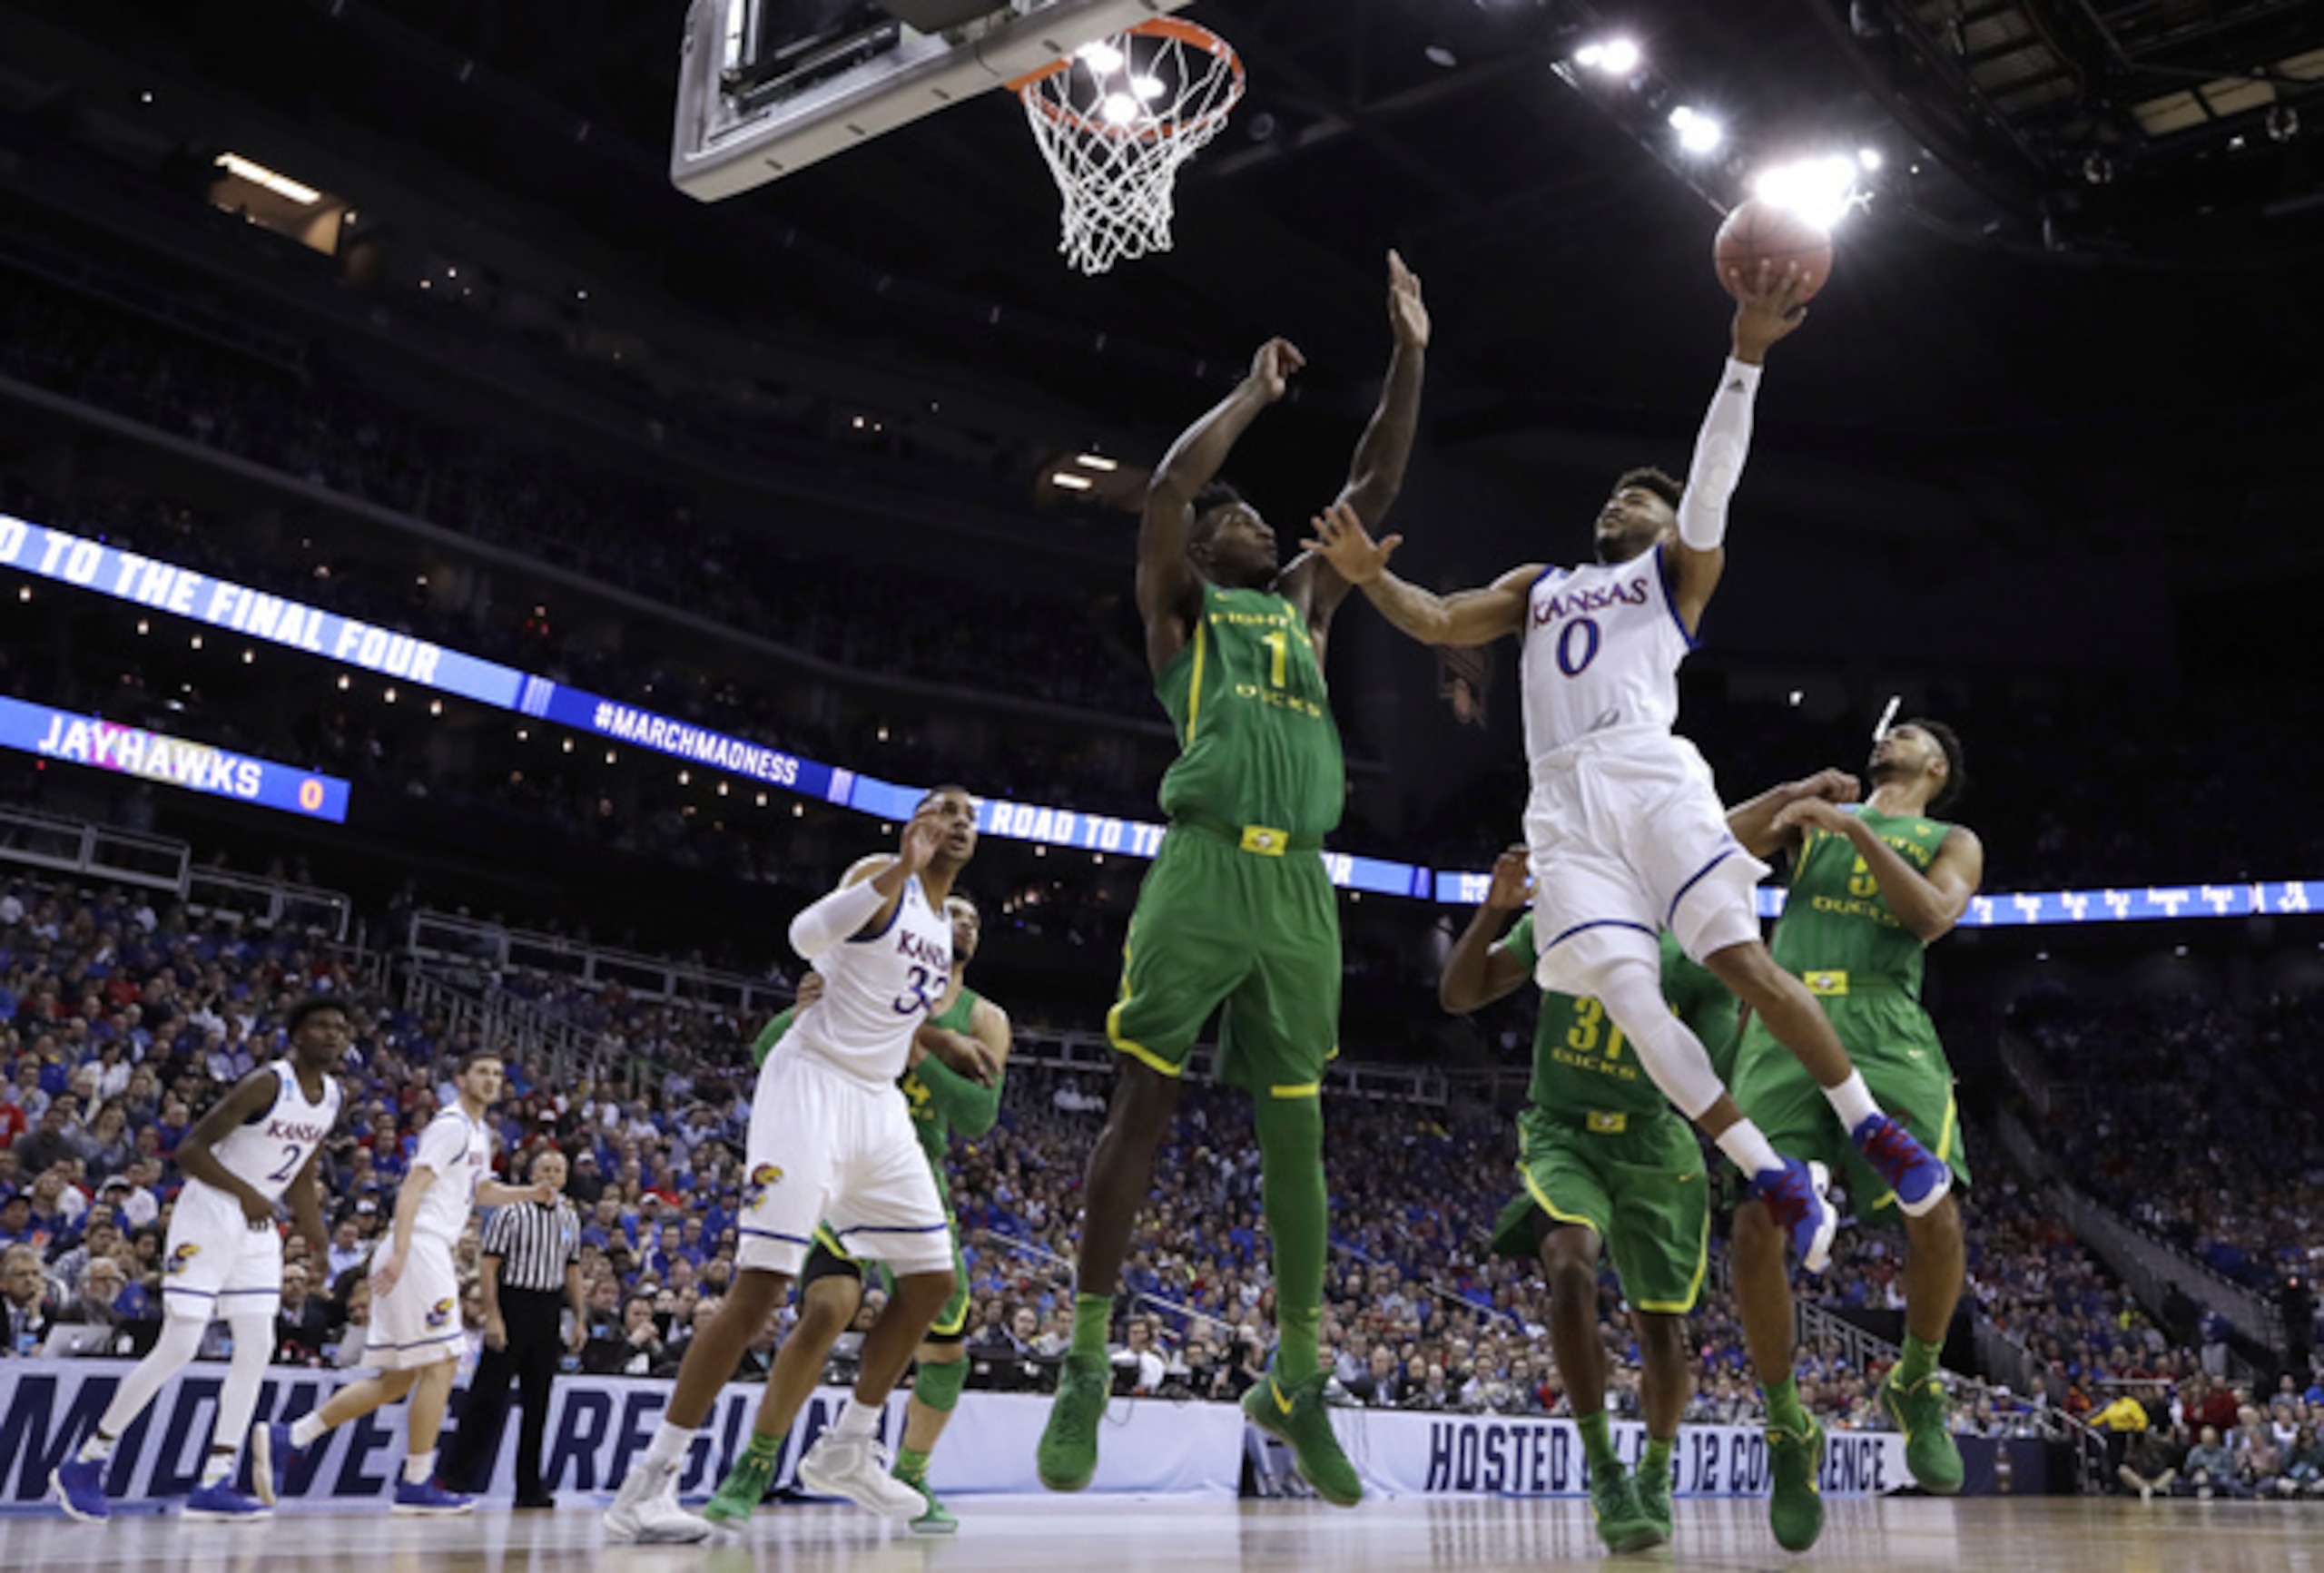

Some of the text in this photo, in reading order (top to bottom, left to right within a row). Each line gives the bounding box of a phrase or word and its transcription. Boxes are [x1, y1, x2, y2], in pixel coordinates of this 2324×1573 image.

[39, 529, 104, 585] TO
[113, 549, 202, 614] THE
[205, 581, 323, 654] FINAL
[334, 619, 441, 685] FOUR
[1532, 577, 1649, 629] KANSAS
[1260, 631, 1286, 688] 1
[1556, 617, 1600, 679] 0
[38, 714, 324, 811] JAYHAWKS 0
[594, 701, 800, 786] #MARCHMADNESS
[989, 799, 1075, 844] ROAD
[1084, 814, 1123, 852] TO
[1132, 821, 1168, 858] TH
[266, 1144, 301, 1183] 2
[1424, 1422, 1570, 1492] HOSTED
[1690, 1433, 1720, 1491] 12
[1730, 1436, 1886, 1491] COENCE
